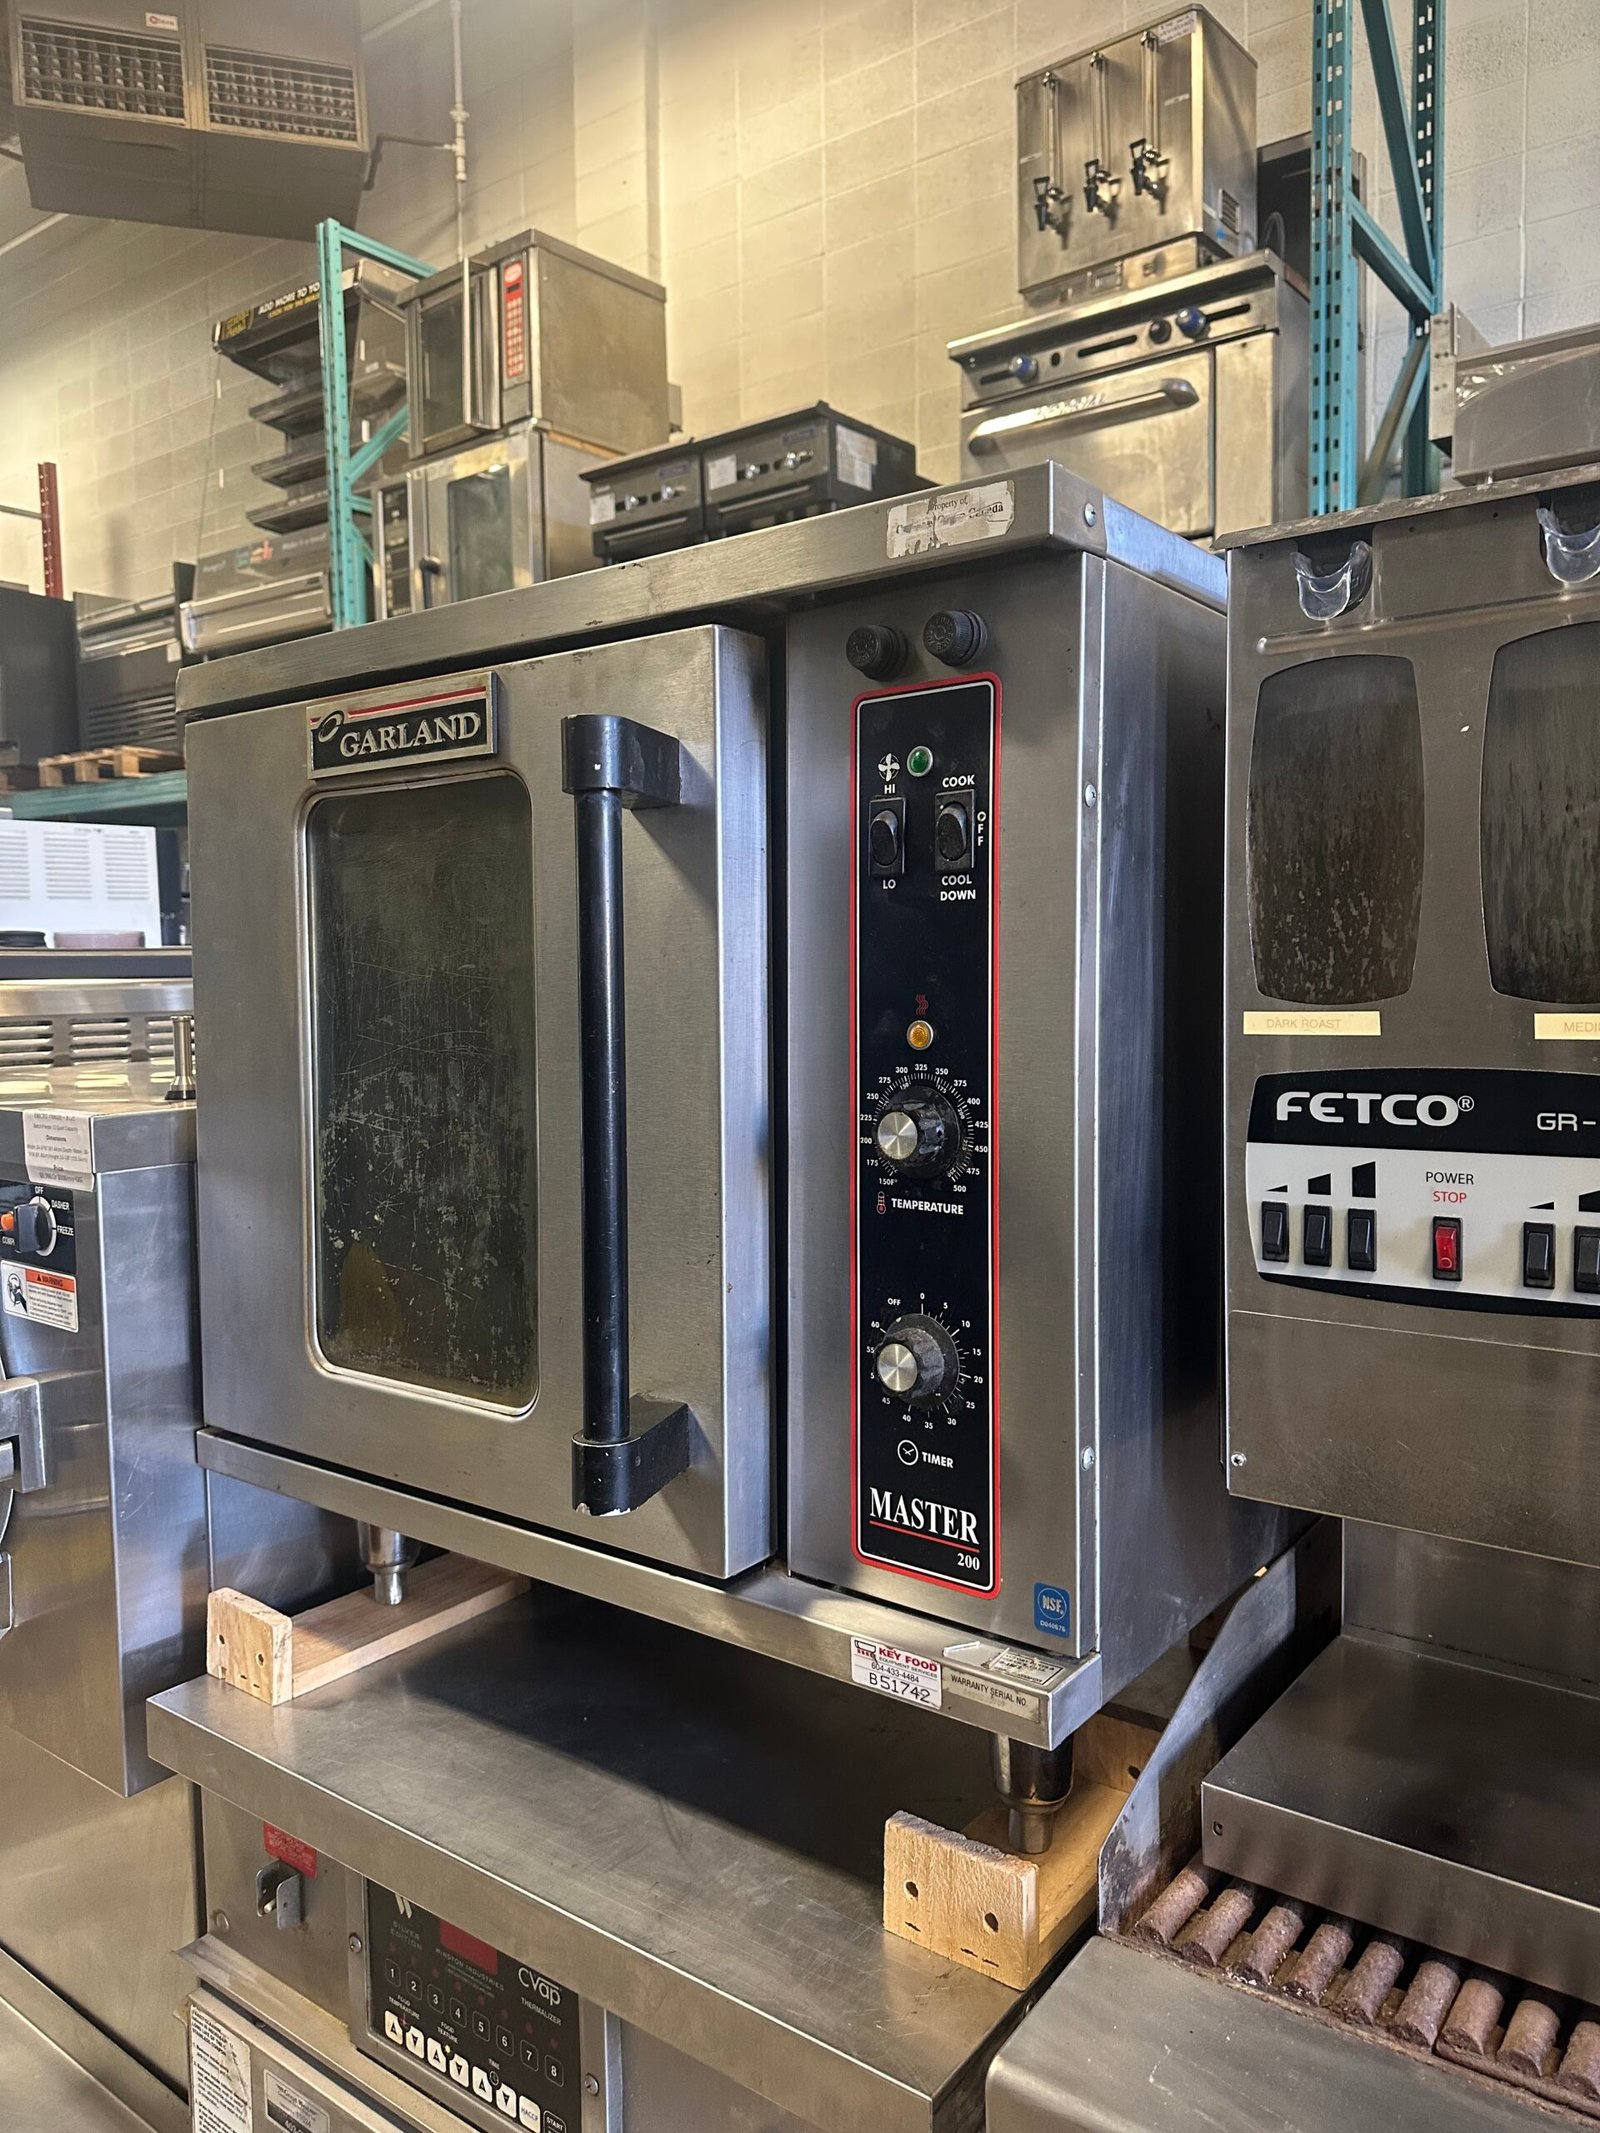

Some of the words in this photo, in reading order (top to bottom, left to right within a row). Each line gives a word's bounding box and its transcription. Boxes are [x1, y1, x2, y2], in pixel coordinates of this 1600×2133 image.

[339, 711, 482, 758] GARLAND
[942, 775, 975, 788] COOK
[884, 784, 896, 794] HI
[883, 879, 896, 889] LO
[941, 874, 972, 886] COOL
[940, 889, 976, 901] DOWN
[1266, 1019, 1297, 1028] DARK
[1301, 1019, 1342, 1028] ROAST
[895, 1066, 908, 1074] 300
[860, 1114, 872, 1122] 225
[975, 1121, 989, 1129] 425
[860, 1137, 872, 1145] 200
[974, 1145, 988, 1153] 450
[1425, 1171, 1475, 1185] POWER
[34, 1186, 44, 1194] OFF
[1433, 1190, 1468, 1204] STOP
[891, 1197, 964, 1215] TEMPERATURE
[57, 1225, 74, 1236] FREEZE
[961, 1320, 971, 1328] 10
[972, 1348, 981, 1356] 15
[882, 1397, 890, 1405] 45
[902, 1414, 911, 1422] 40
[924, 1421, 933, 1429] 35
[921, 1451, 953, 1468] TIMER
[869, 1487, 980, 1545] MASTER
[957, 1552, 981, 1571] 200
[878, 1647, 901, 1660] KEY
[905, 1655, 938, 1672] FOOD
[871, 1662, 919, 1683] 604-433-4484
[879, 1657, 910, 1669] EQUIPMENT
[911, 1666, 938, 1679] SERVICES
[951, 1674, 989, 1693] WARRANTY
[990, 1687, 1014, 1703] SERIAL
[435, 1948, 464, 1967] WINSTON
[465, 1965, 505, 1991] INDUSTRIES
[411, 1981, 417, 1992] 2
[518, 1966, 561, 2006] CVap
[432, 1994, 439, 2004] 3
[455, 2008, 461, 2018] 4
[521, 1997, 562, 2026] THERMALIZER
[440, 2021, 455, 2034] FOOD
[478, 2022, 484, 2032] 5
[437, 2026, 459, 2044] TEXTURE
[502, 2036, 508, 2047] 6
[526, 2050, 533, 2061] 7
[551, 2065, 557, 2077] 8
[546, 2116, 563, 2131] START
